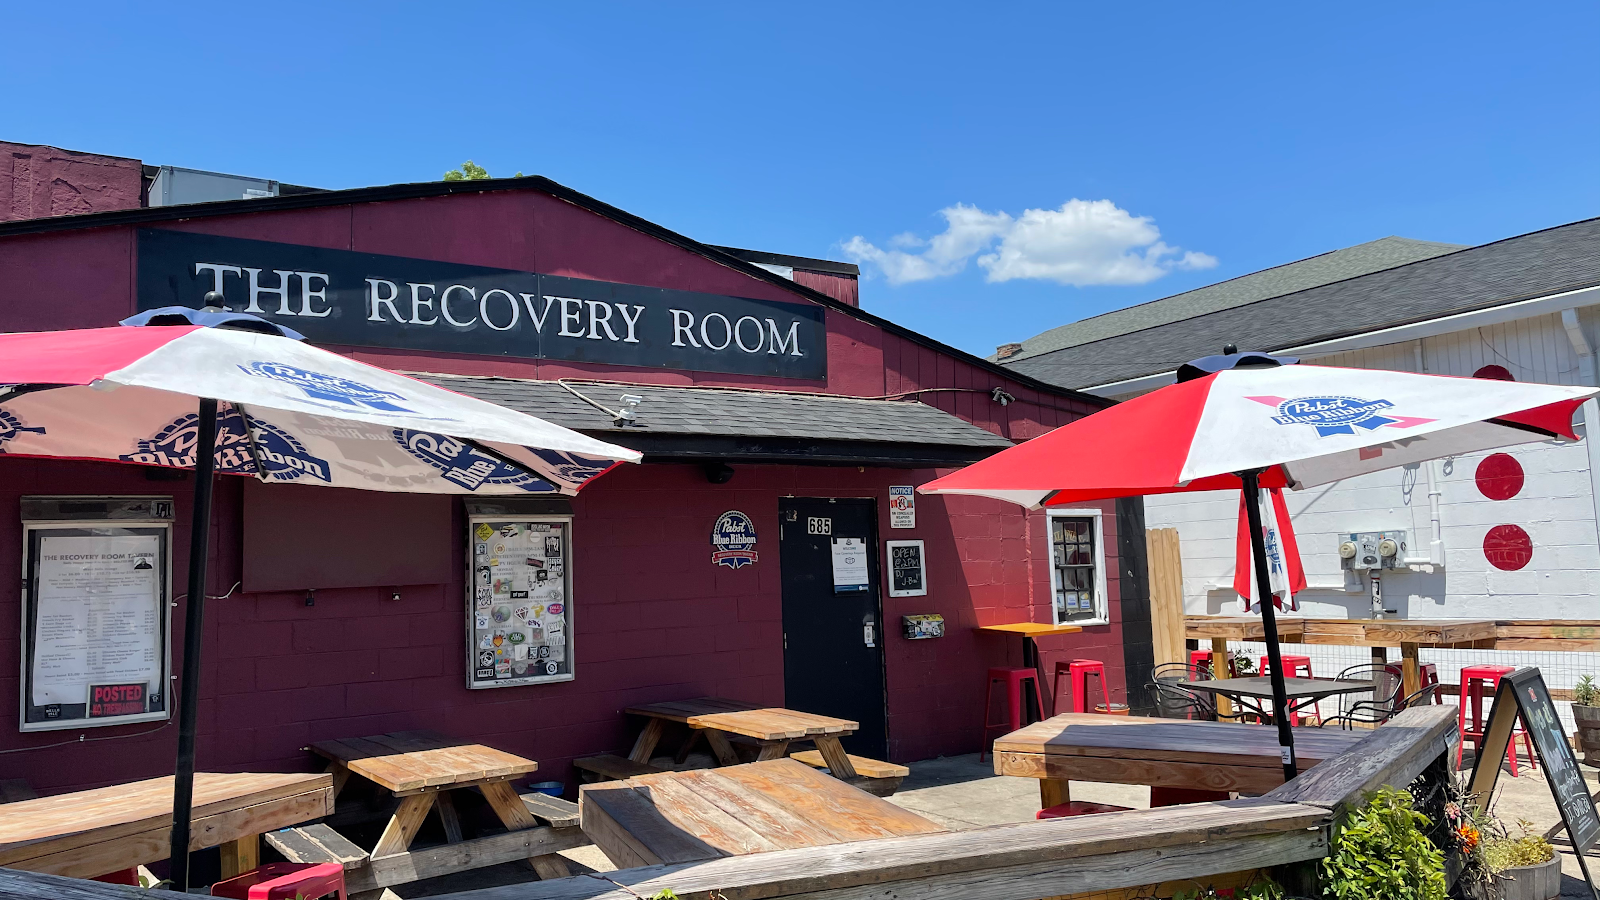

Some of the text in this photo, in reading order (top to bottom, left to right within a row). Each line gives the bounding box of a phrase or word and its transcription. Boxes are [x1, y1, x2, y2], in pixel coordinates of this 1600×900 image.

[195, 262, 805, 357] THE RECOVERY ROOM
[1278, 402, 1388, 425] Blue Ribbon
[1295, 399, 1347, 414] Pabst
[155, 426, 268, 457] Pbst
[128, 450, 198, 468] Blu
[445, 459, 495, 489] Blue
[891, 487, 912, 495] NOTICE
[720, 517, 746, 533] Pabst
[809, 518, 830, 534] 685
[713, 533, 756, 545] Blue Ribbon
[893, 547, 915, 558] OPEN
[95, 685, 142, 703] POSTED
